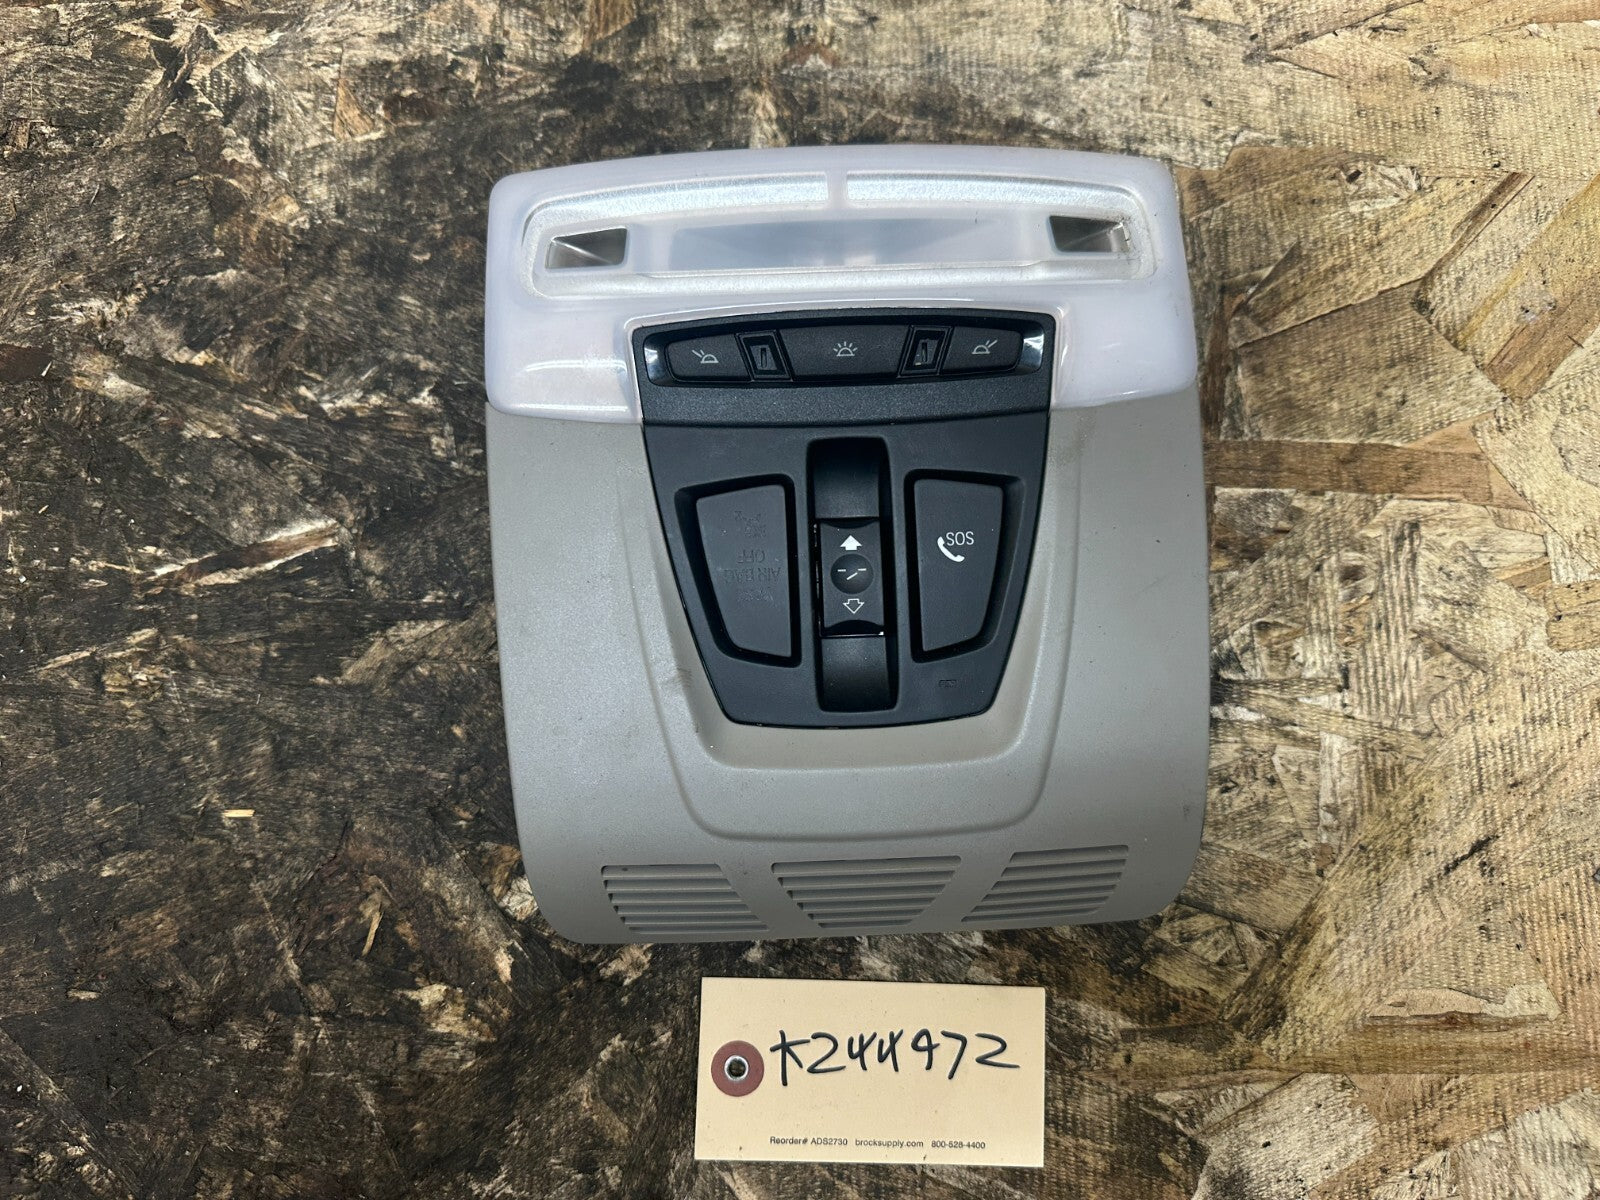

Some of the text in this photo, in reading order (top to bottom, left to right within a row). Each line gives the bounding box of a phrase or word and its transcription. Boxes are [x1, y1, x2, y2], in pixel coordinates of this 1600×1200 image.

[945, 531, 975, 546] SOS
[769, 1136, 986, 1150] Reorder# ADS2730 brocksupply.com 800-528-4400
